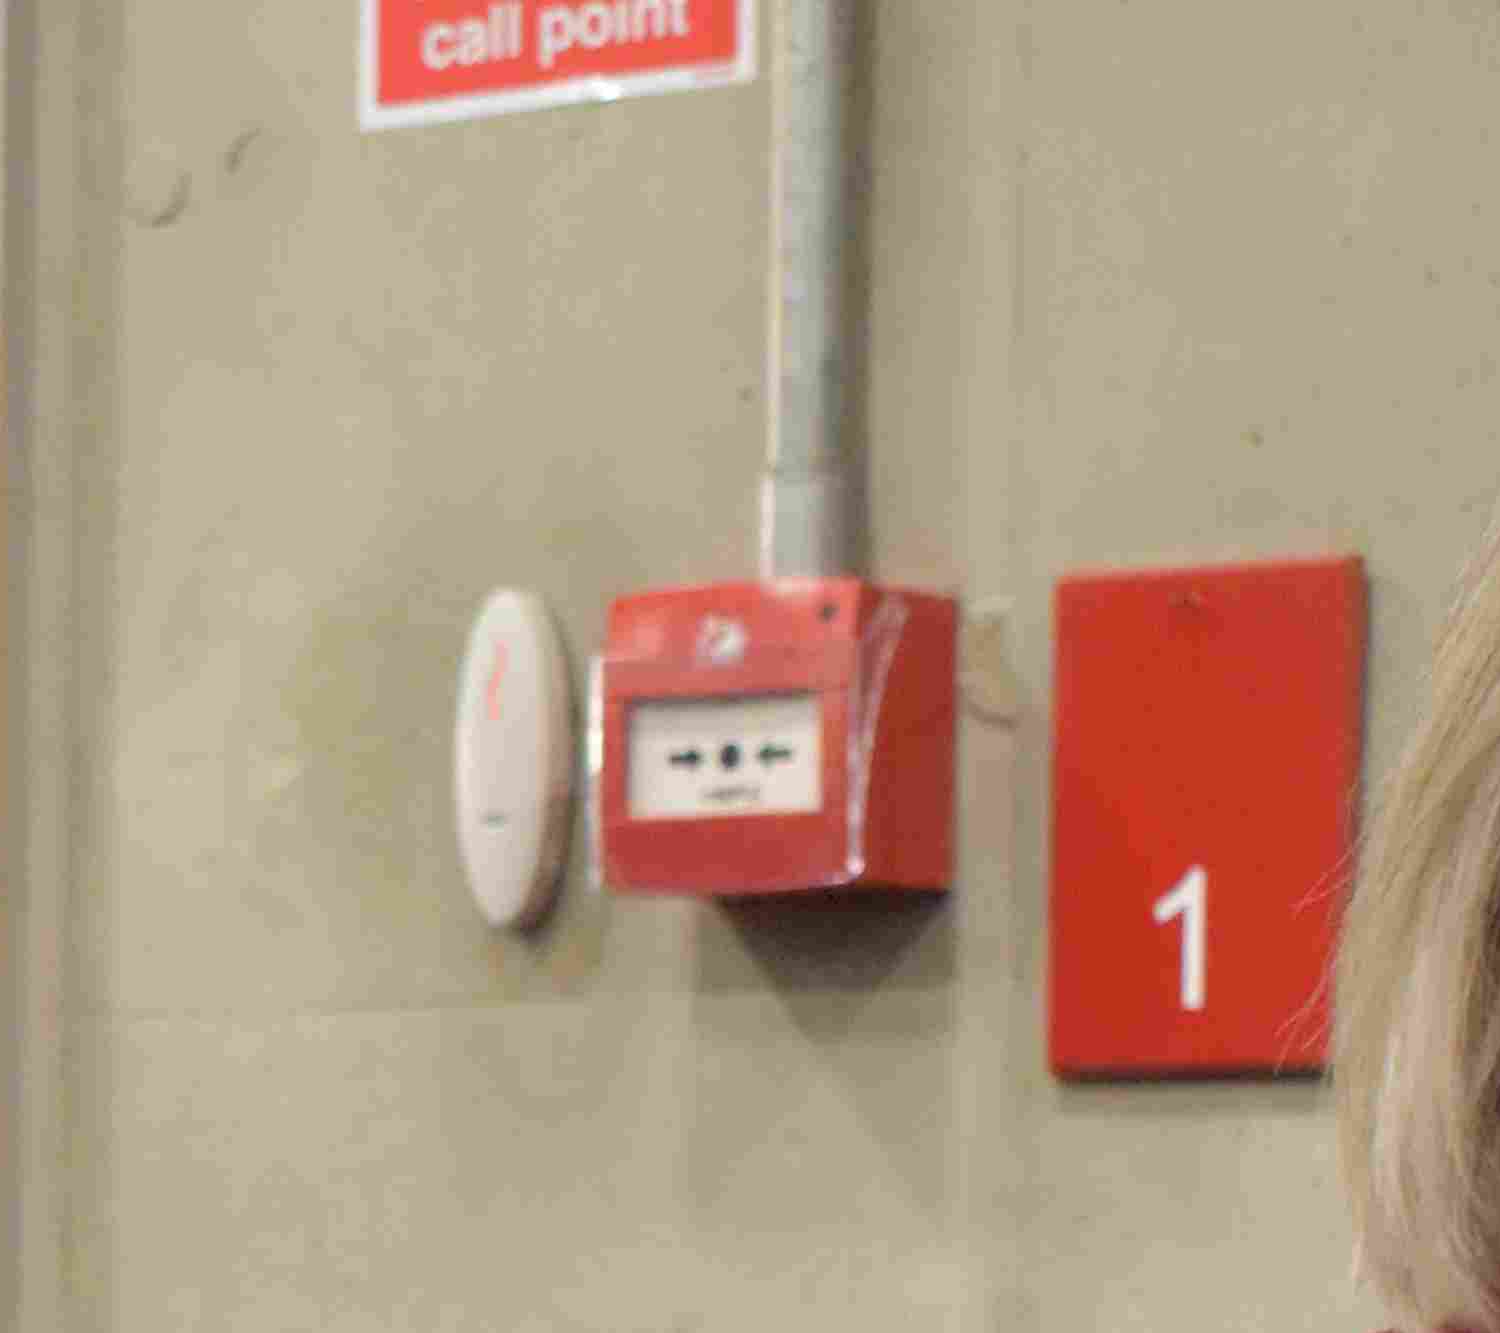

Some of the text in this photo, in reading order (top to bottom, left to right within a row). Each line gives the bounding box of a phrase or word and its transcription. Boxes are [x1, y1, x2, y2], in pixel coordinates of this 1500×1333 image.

[421, 0, 688, 70] call point
[1151, 866, 1207, 1010] 1
